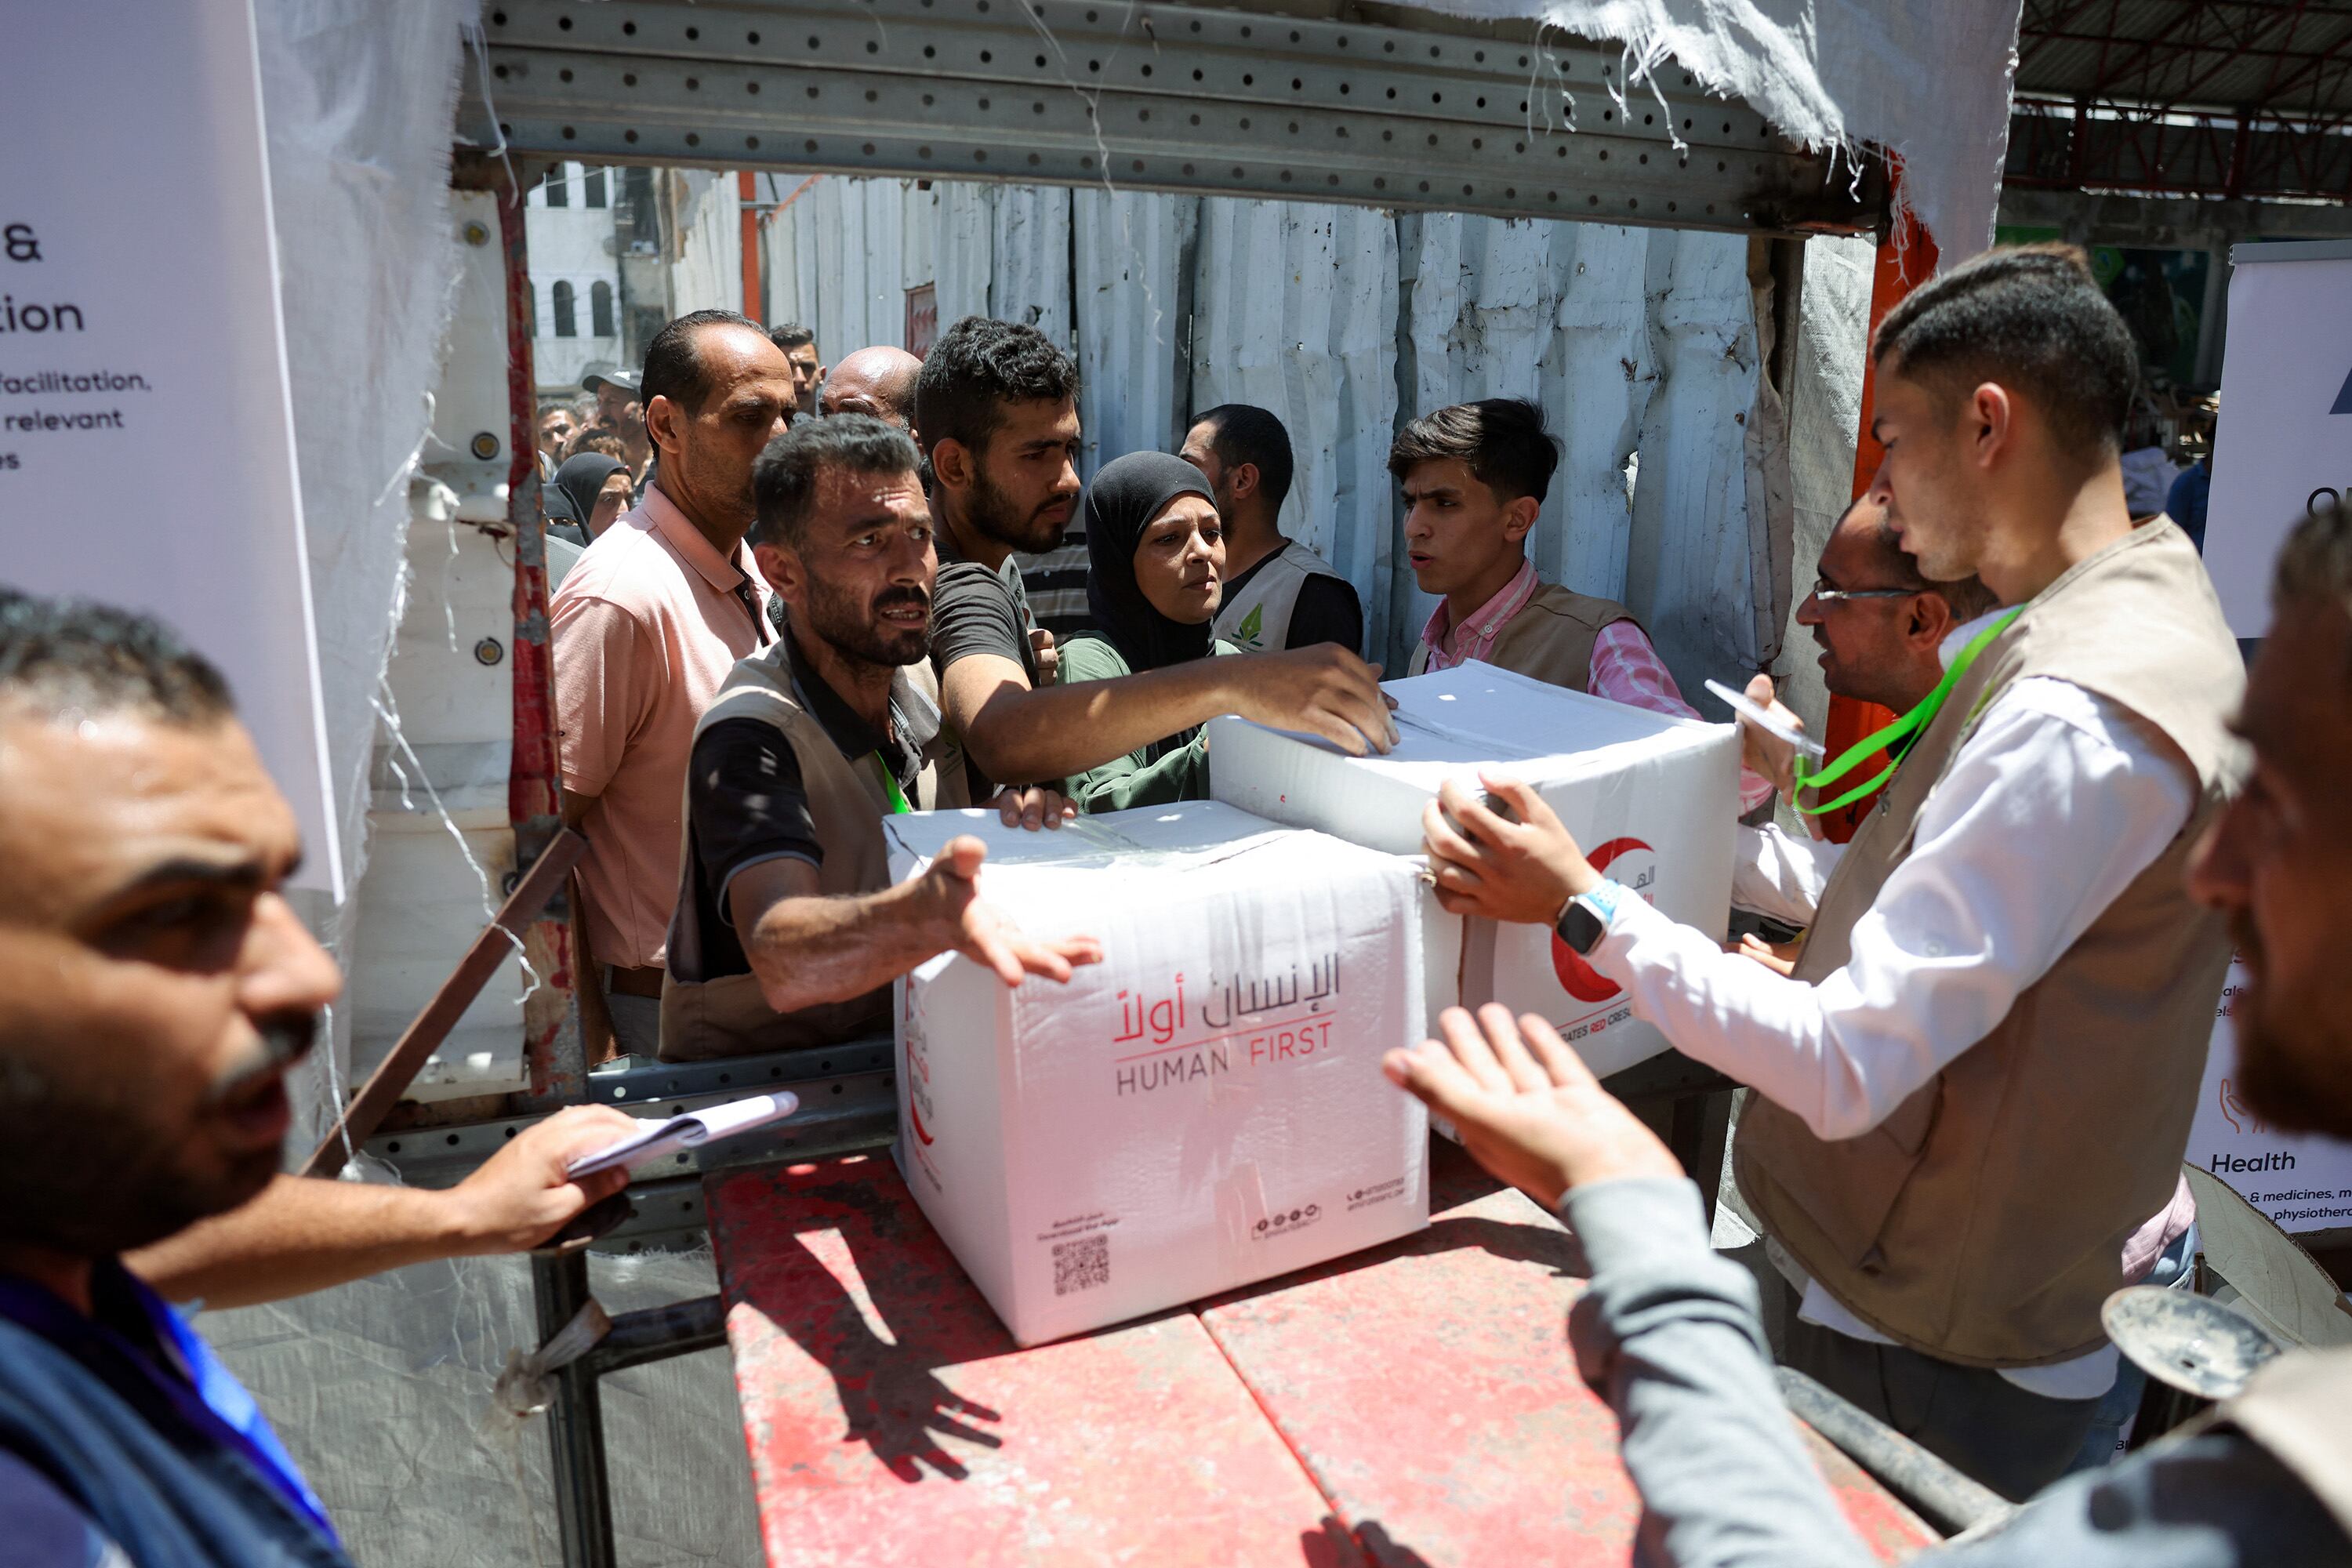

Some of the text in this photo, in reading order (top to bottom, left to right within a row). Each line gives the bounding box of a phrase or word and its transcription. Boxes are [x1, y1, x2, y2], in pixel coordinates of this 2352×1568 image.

[4, 223, 42, 263] &
[5, 408, 125, 431] relevant
[1203, 953, 1340, 1029] الإنسان
[1589, 1018, 1606, 1034] RED
[1116, 1022, 1333, 1096] HUMAN FIRST
[2211, 1152, 2296, 1173] Health
[2249, 1192, 2259, 1203] &
[2263, 1189, 2335, 1202] medicines,
